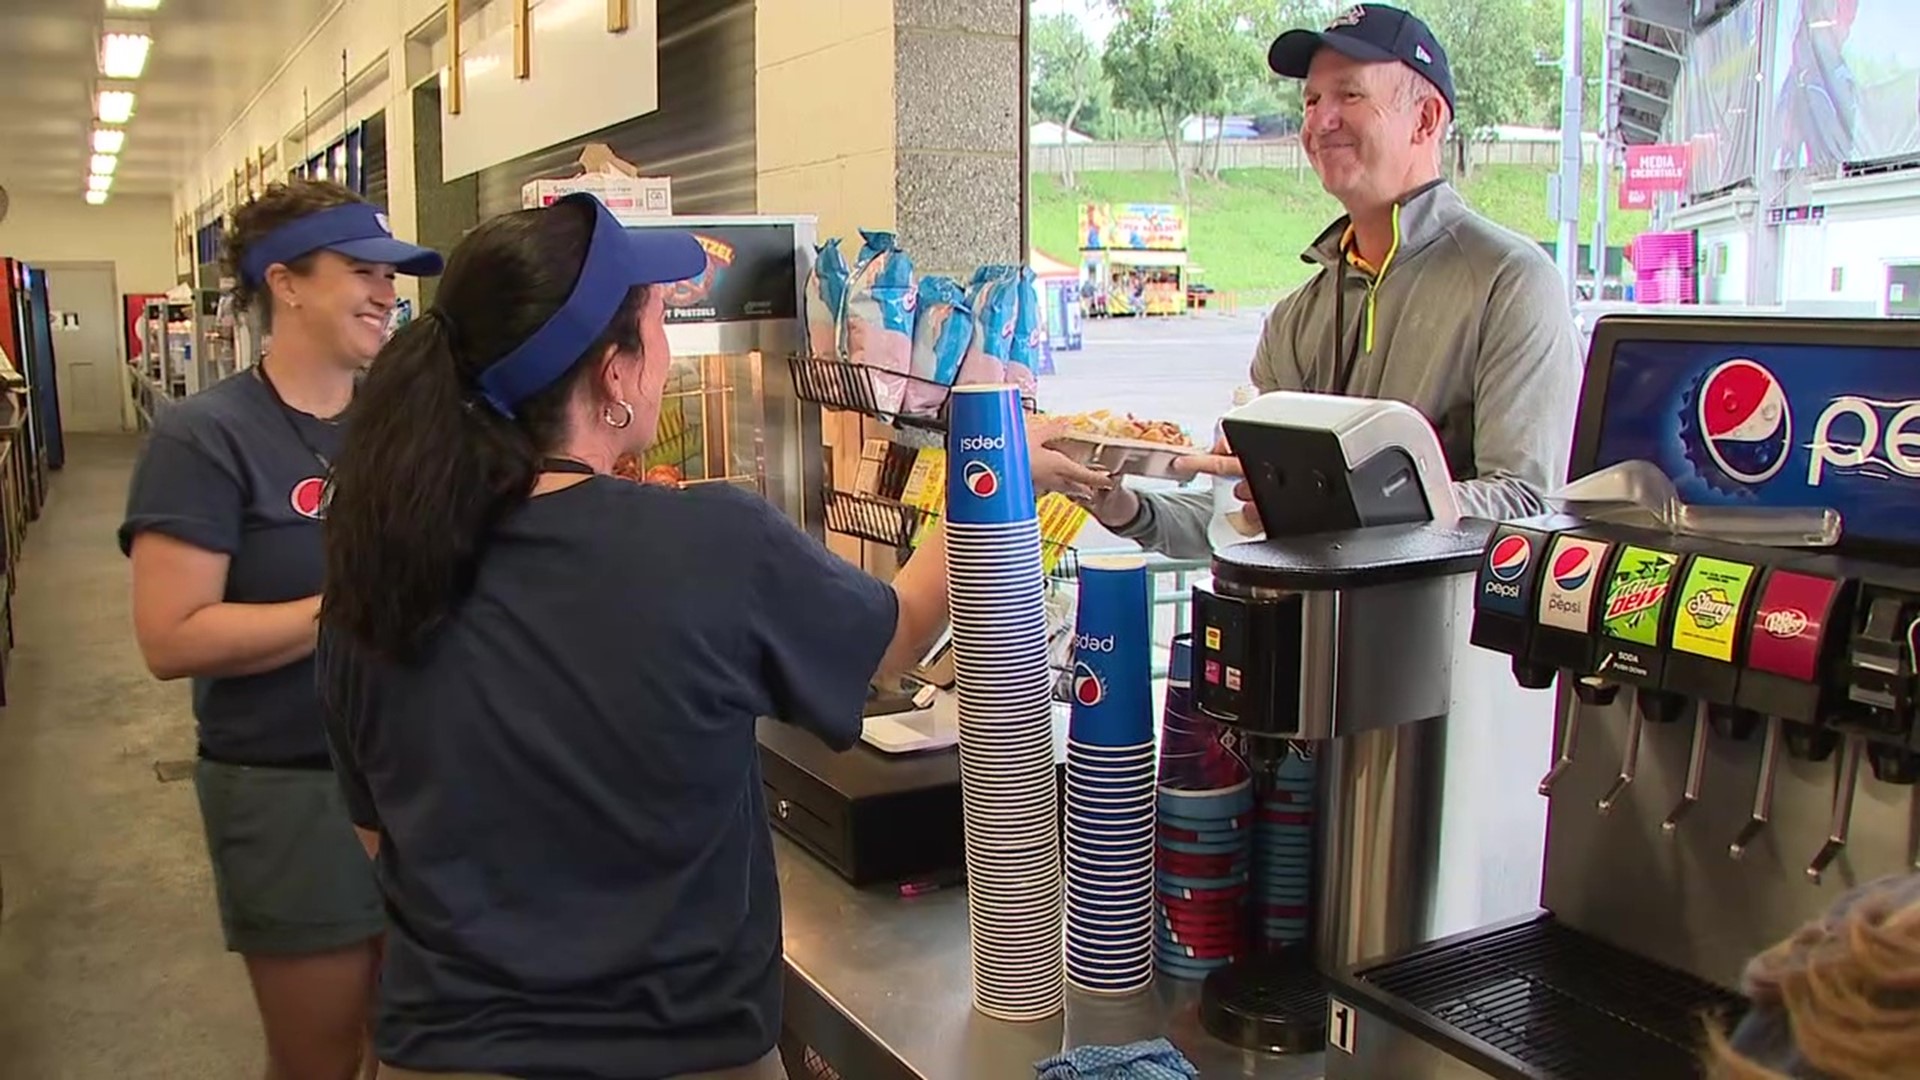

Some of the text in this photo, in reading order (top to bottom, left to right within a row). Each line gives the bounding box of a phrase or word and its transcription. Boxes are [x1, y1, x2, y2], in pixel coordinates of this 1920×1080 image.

[1640, 155, 1675, 168] MEDIA
[699, 236, 733, 264] TZEL
[960, 433, 1006, 453] pepsi
[1485, 580, 1520, 598] pepsi
[1549, 597, 1581, 614] pepsi
[1687, 591, 1735, 623] Starry
[1074, 634, 1115, 653] peps
[1618, 652, 1639, 664] SODA
[1336, 1007, 1348, 1048] 1
